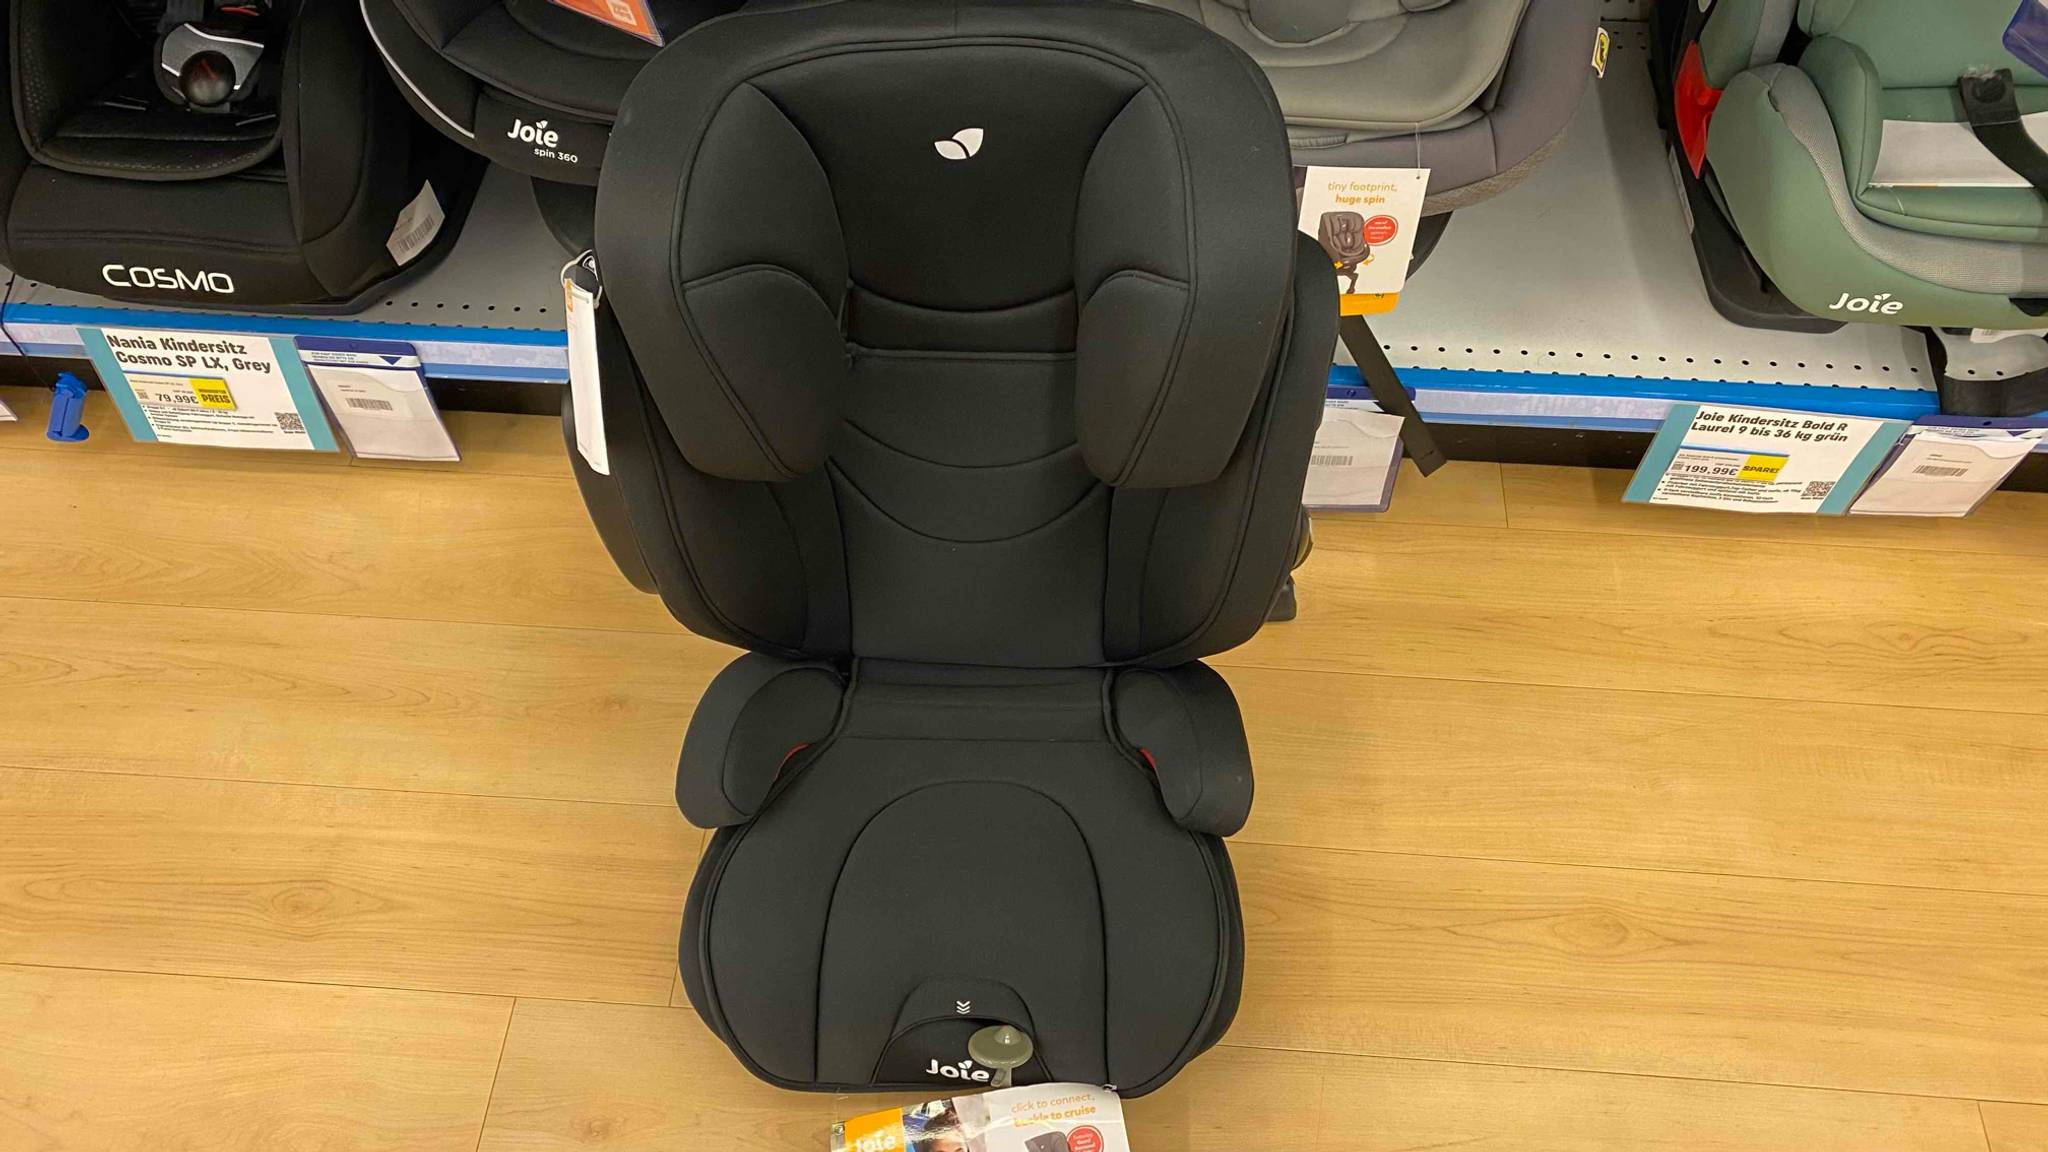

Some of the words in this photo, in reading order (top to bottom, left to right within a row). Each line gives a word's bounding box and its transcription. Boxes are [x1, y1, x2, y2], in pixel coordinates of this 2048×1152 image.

[507, 118, 559, 148] Joie
[534, 148, 555, 159] spin
[557, 151, 578, 163] 360
[1327, 182, 1347, 192] tiny
[1348, 181, 1398, 192] footprint,
[1335, 195, 1362, 206] huge
[1363, 195, 1386, 205] spin
[102, 264, 235, 293] COSMO
[1828, 292, 1904, 315] Joie
[106, 334, 157, 350] Nania
[160, 338, 247, 355] Kindersitz
[116, 351, 172, 366] Cosmo
[176, 355, 197, 368] SP
[202, 357, 229, 372] LX,
[232, 358, 271, 374] Grey
[201, 393, 231, 404] PREIS
[1691, 421, 1734, 434] Laurel
[1738, 425, 1747, 435] 9
[1749, 427, 1770, 437] bis
[1774, 429, 1791, 439] 36
[1795, 430, 1813, 442] kg
[1814, 431, 1848, 443] grün
[1696, 411, 1725, 423] Joie
[1728, 413, 1799, 429] Kindersitz
[1802, 420, 1834, 431] Bold
[1837, 422, 1849, 432] R
[926, 1058, 990, 1083] Joie
[1011, 1100, 1034, 1113] click
[1037, 1100, 1048, 1109] to
[1050, 1111, 1062, 1120] to
[1064, 1105, 1096, 1118] cruise
